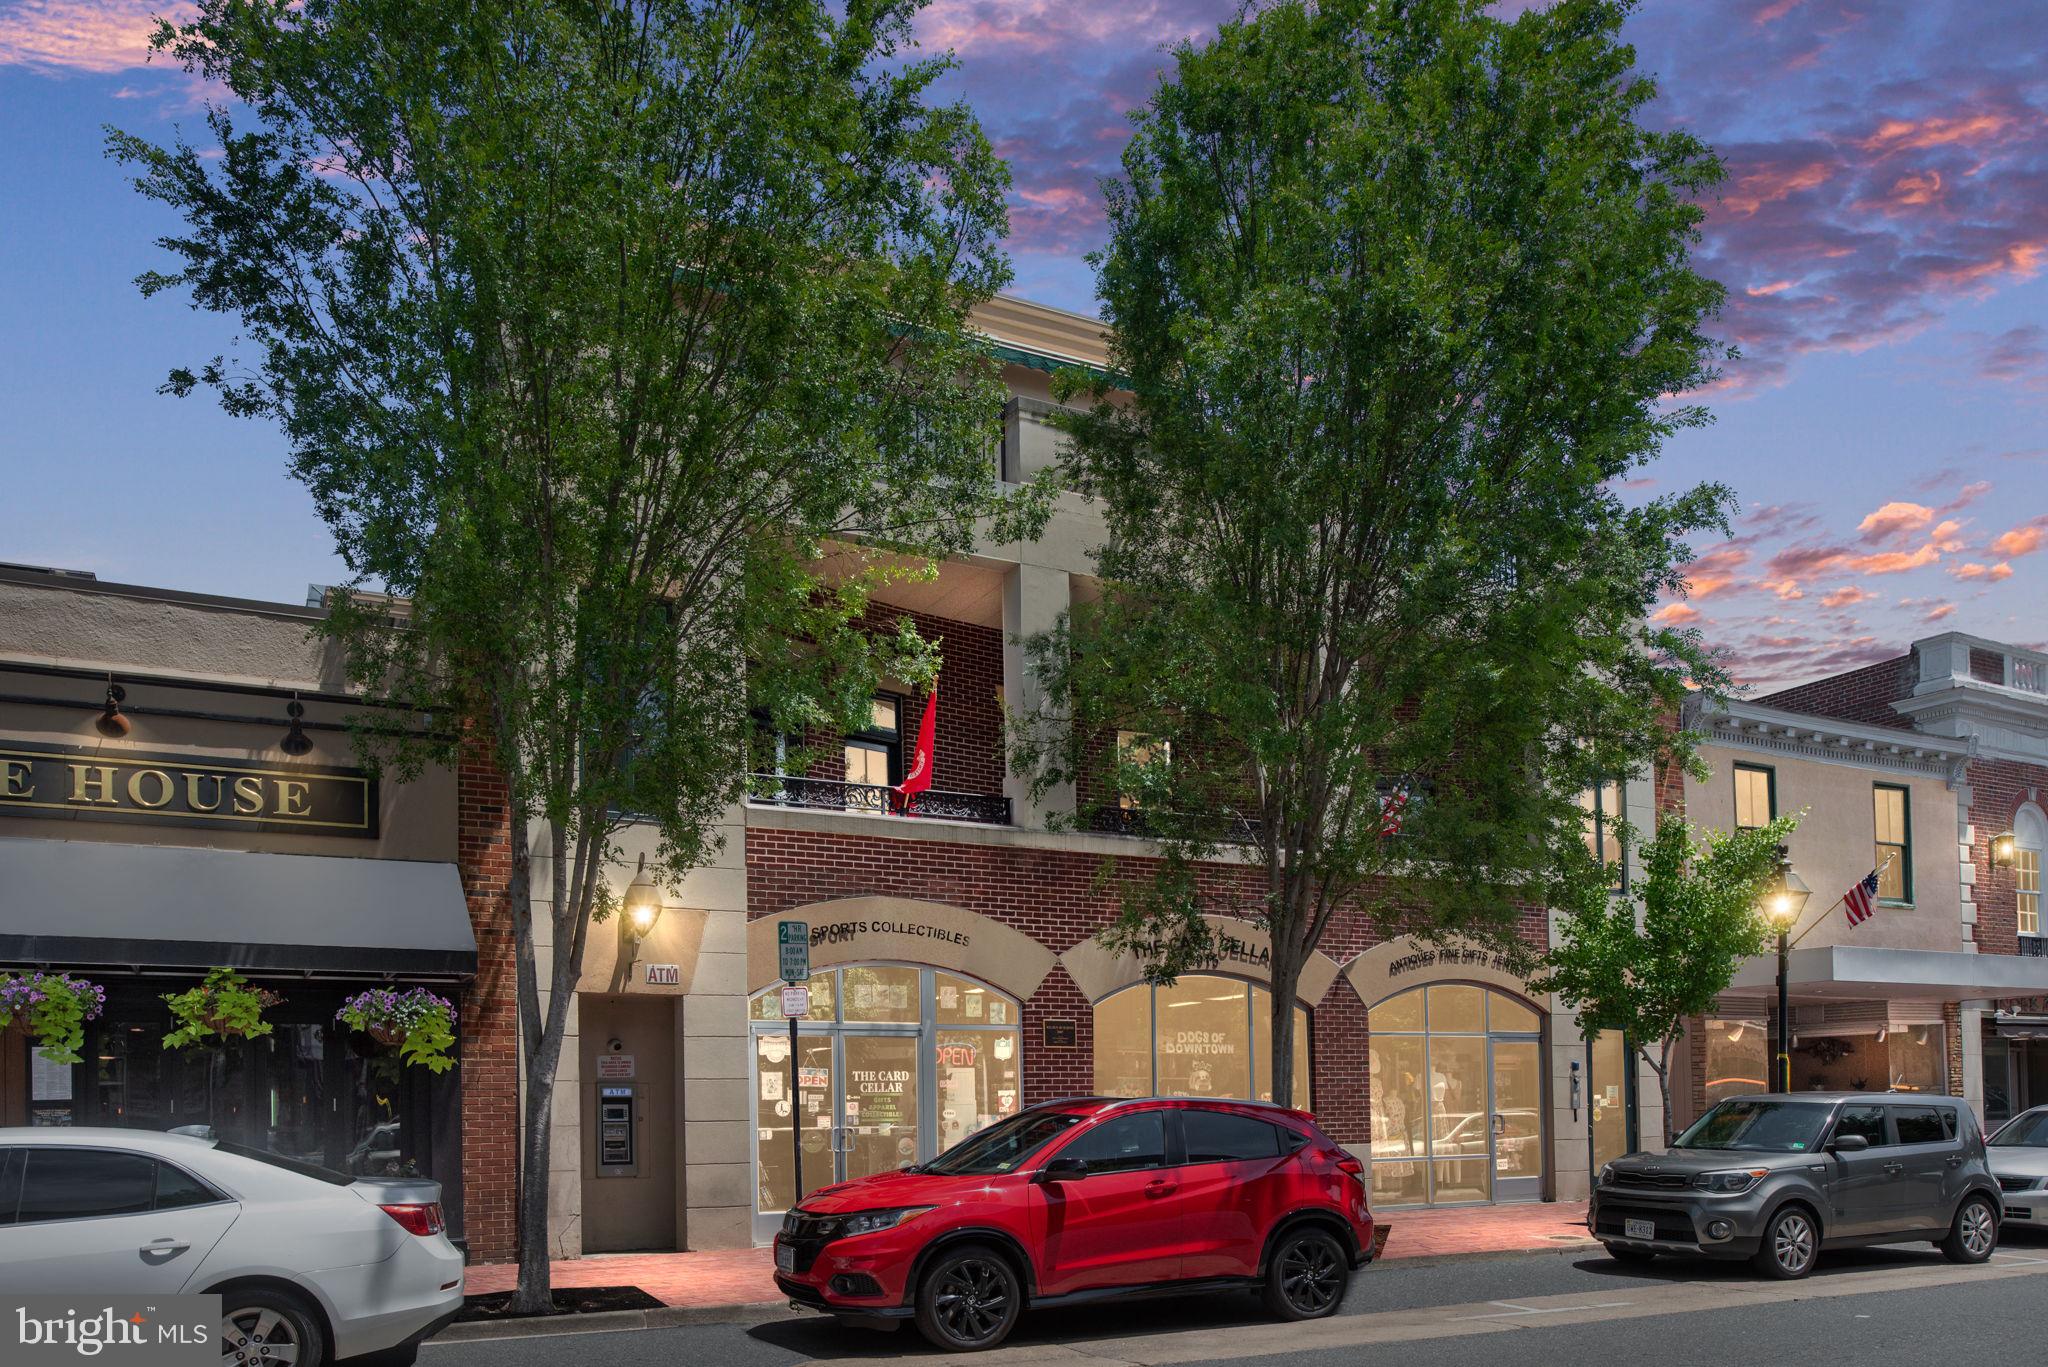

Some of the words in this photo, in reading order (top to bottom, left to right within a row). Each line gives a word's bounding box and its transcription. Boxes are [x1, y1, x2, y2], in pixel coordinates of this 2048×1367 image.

[67, 764, 312, 817] HOUSE
[780, 925, 788, 941] 2
[788, 934, 807, 942] PARKING
[811, 921, 867, 940] SPORTS
[871, 921, 970, 947] COLLECTIBLES
[1389, 950, 1436, 973] ANTIQUES
[1440, 948, 1461, 959] FINE
[1463, 950, 1488, 961] GIFTS
[648, 966, 679, 982] ATM
[1177, 1030, 1210, 1044] DOGS
[1211, 1032, 1226, 1044] OF
[1165, 1042, 1235, 1055] DOWNTOWN
[852, 1070, 877, 1081] THE
[878, 1070, 910, 1081] CARD
[609, 1088, 626, 1096] ATM
[860, 1082, 904, 1093] CELLAR
